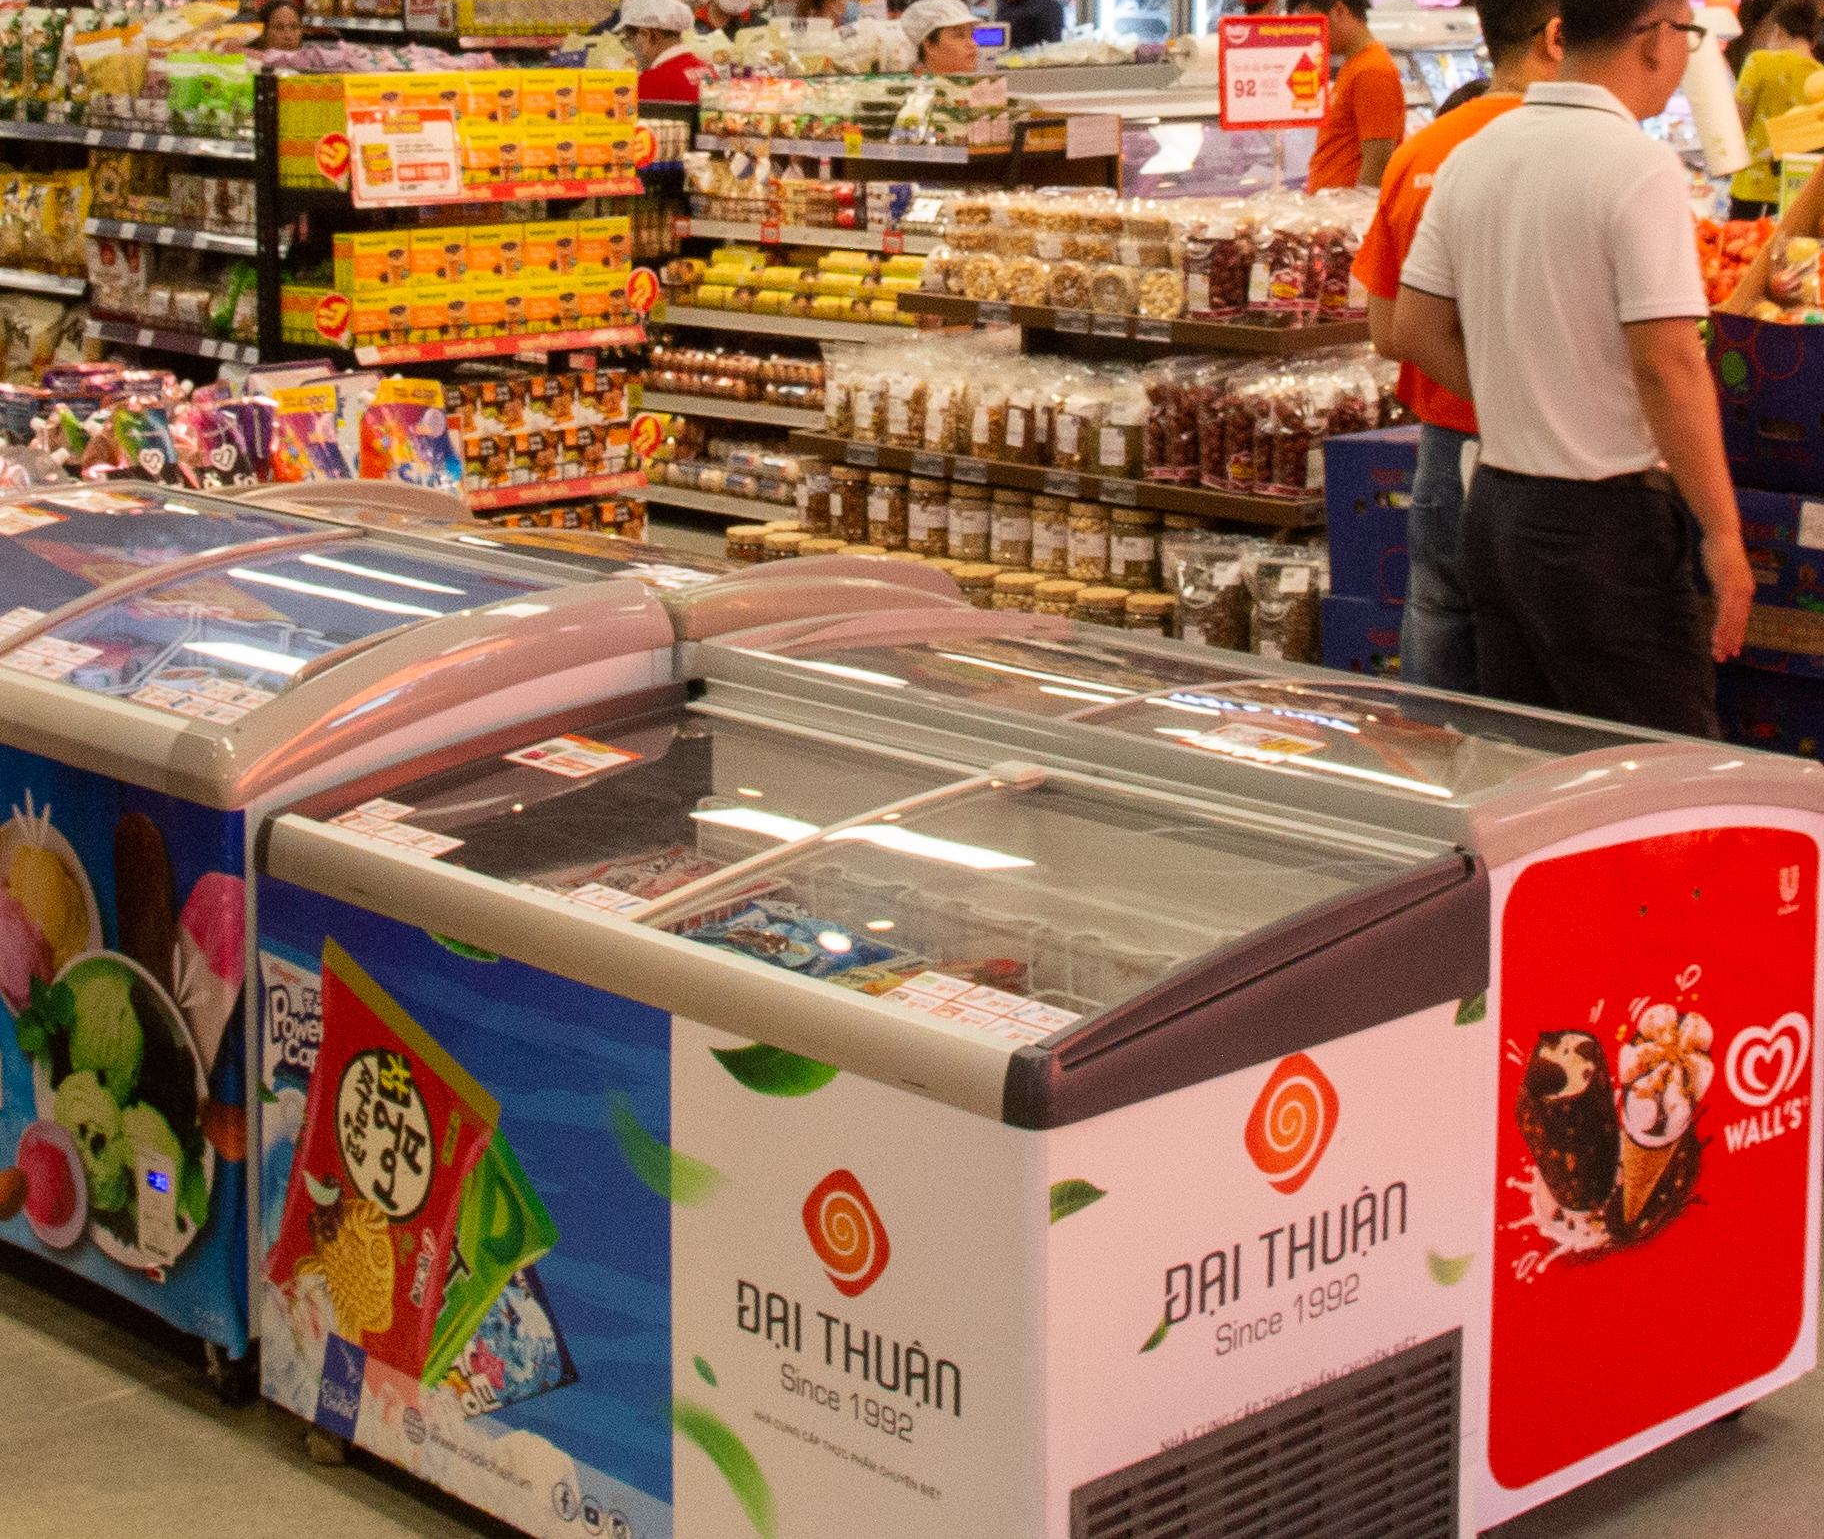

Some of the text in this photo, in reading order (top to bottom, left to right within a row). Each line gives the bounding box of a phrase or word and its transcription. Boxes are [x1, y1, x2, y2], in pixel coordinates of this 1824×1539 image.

[1234, 79, 1256, 98] 92
[269, 985, 323, 1044] Powe
[1725, 1104, 1804, 1153] WALL'S
[1164, 1180, 1406, 1326] ĐẠI THUẬN
[737, 1279, 961, 1418] ĐẠI THUẬN
[1215, 1272, 1360, 1357] Since 1992
[780, 1363, 914, 1443] Since 1992
